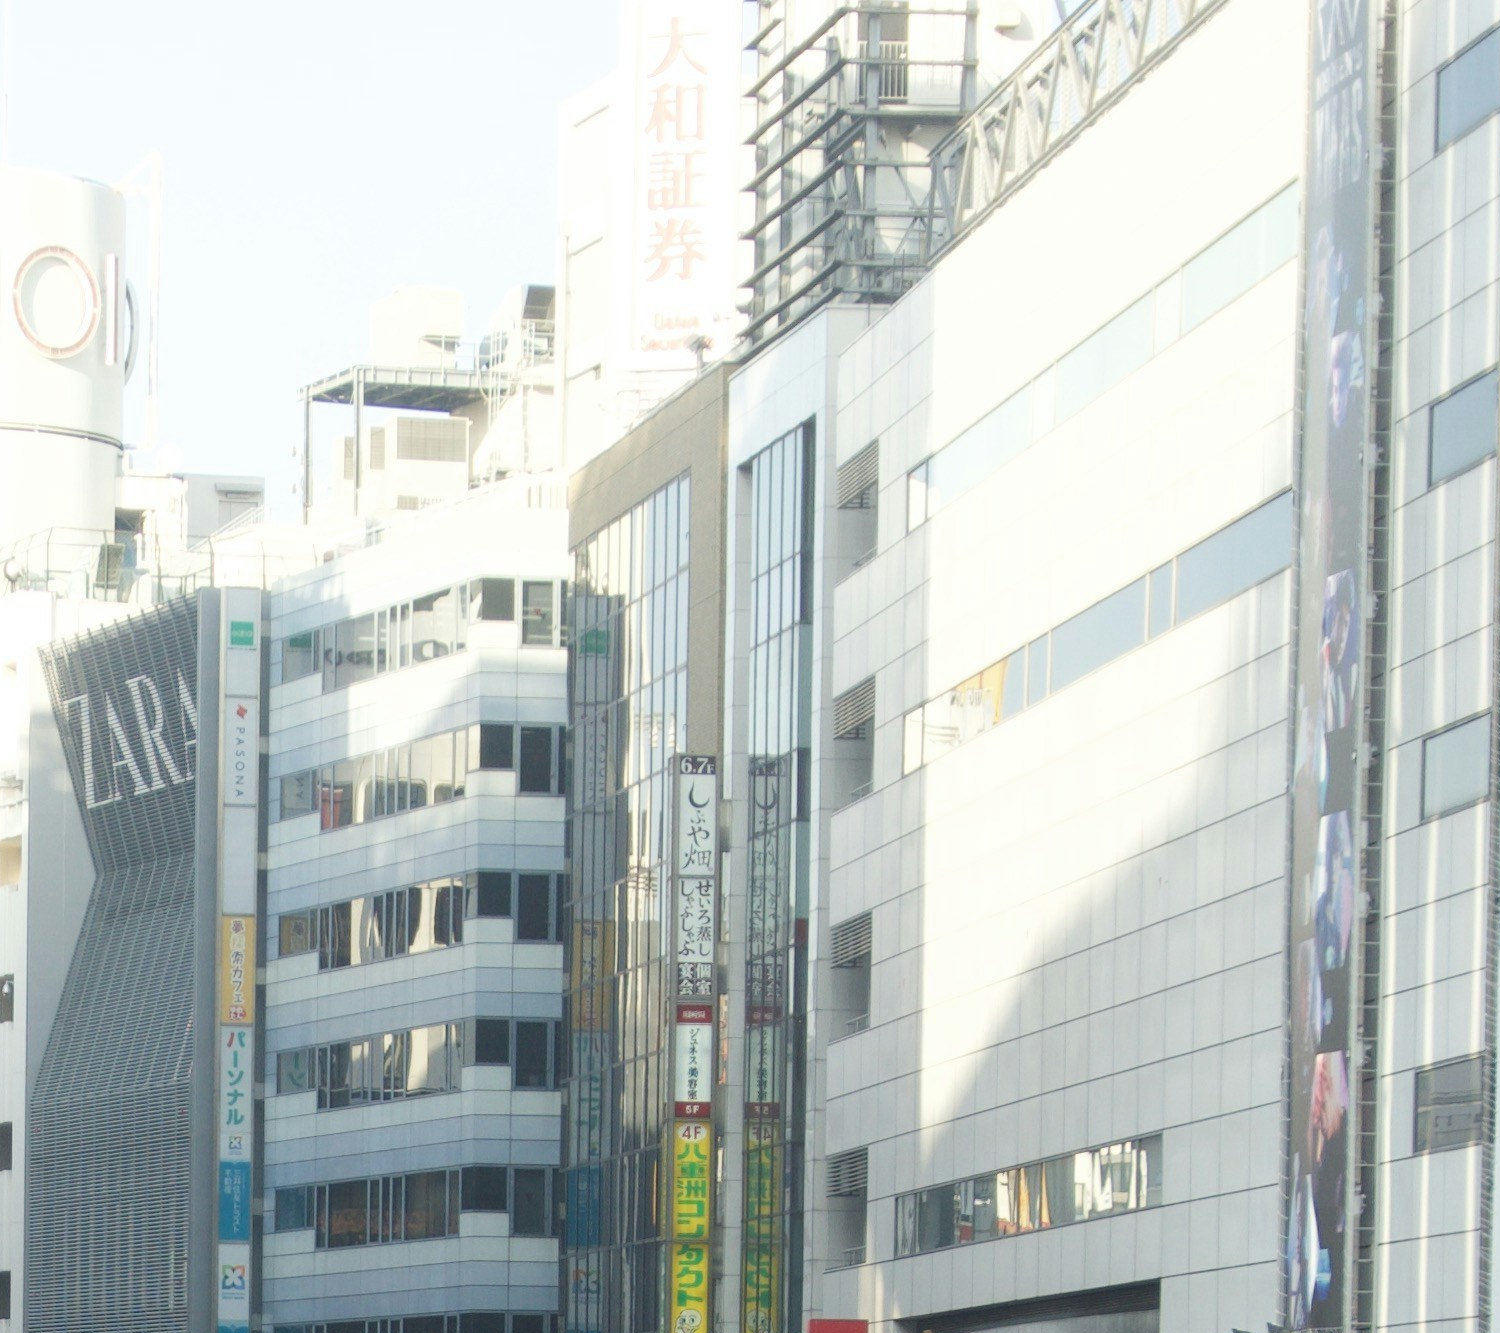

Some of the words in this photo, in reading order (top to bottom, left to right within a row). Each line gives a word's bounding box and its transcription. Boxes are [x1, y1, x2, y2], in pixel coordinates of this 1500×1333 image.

[645, 16, 709, 283] 大和証券
[64, 668, 196, 808] ZARA
[234, 726, 245, 798] PASONA
[681, 778, 713, 872] しぶや畑
[225, 1031, 246, 1126] パーソナル
[681, 1125, 702, 1141] 4F
[676, 1143, 707, 1308] 八重洲コンタクト
